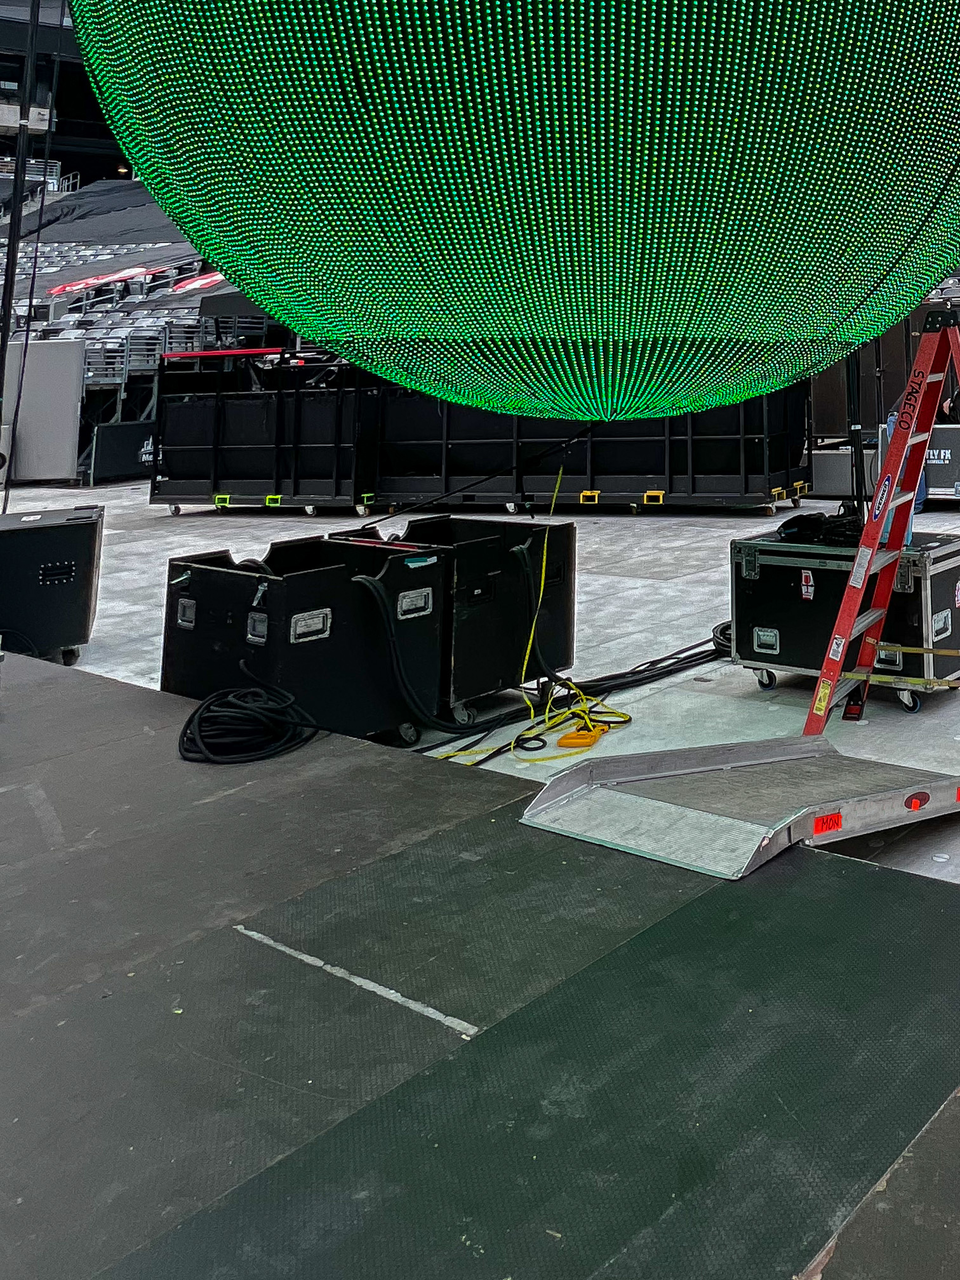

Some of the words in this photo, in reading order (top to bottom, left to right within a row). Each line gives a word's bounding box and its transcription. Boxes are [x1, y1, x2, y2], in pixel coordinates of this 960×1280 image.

[898, 368, 925, 431] STAGECO
[940, 449, 952, 460] FX
[820, 815, 840, 832] MON
